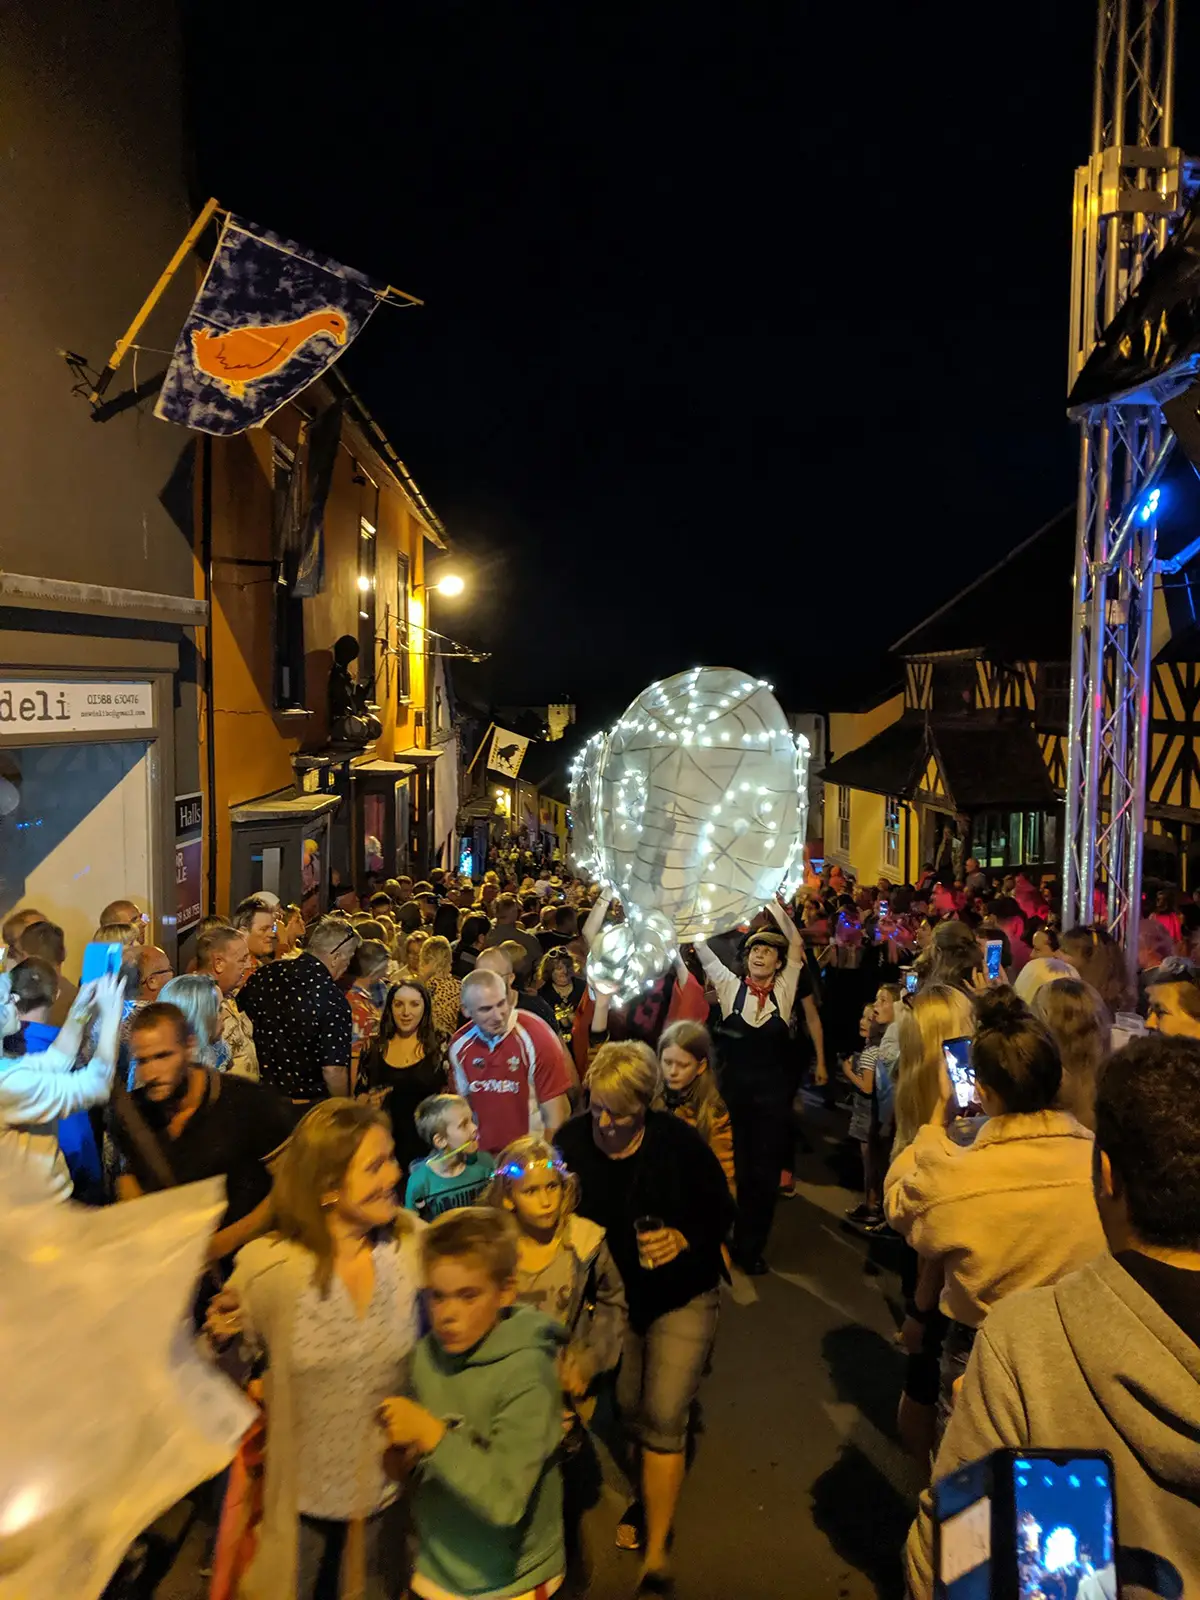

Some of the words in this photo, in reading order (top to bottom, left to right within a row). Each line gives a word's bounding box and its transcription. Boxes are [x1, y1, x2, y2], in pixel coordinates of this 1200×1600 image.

[0, 690, 71, 721] deli
[87, 694, 112, 704] 01588
[180, 803, 201, 828] Halls
